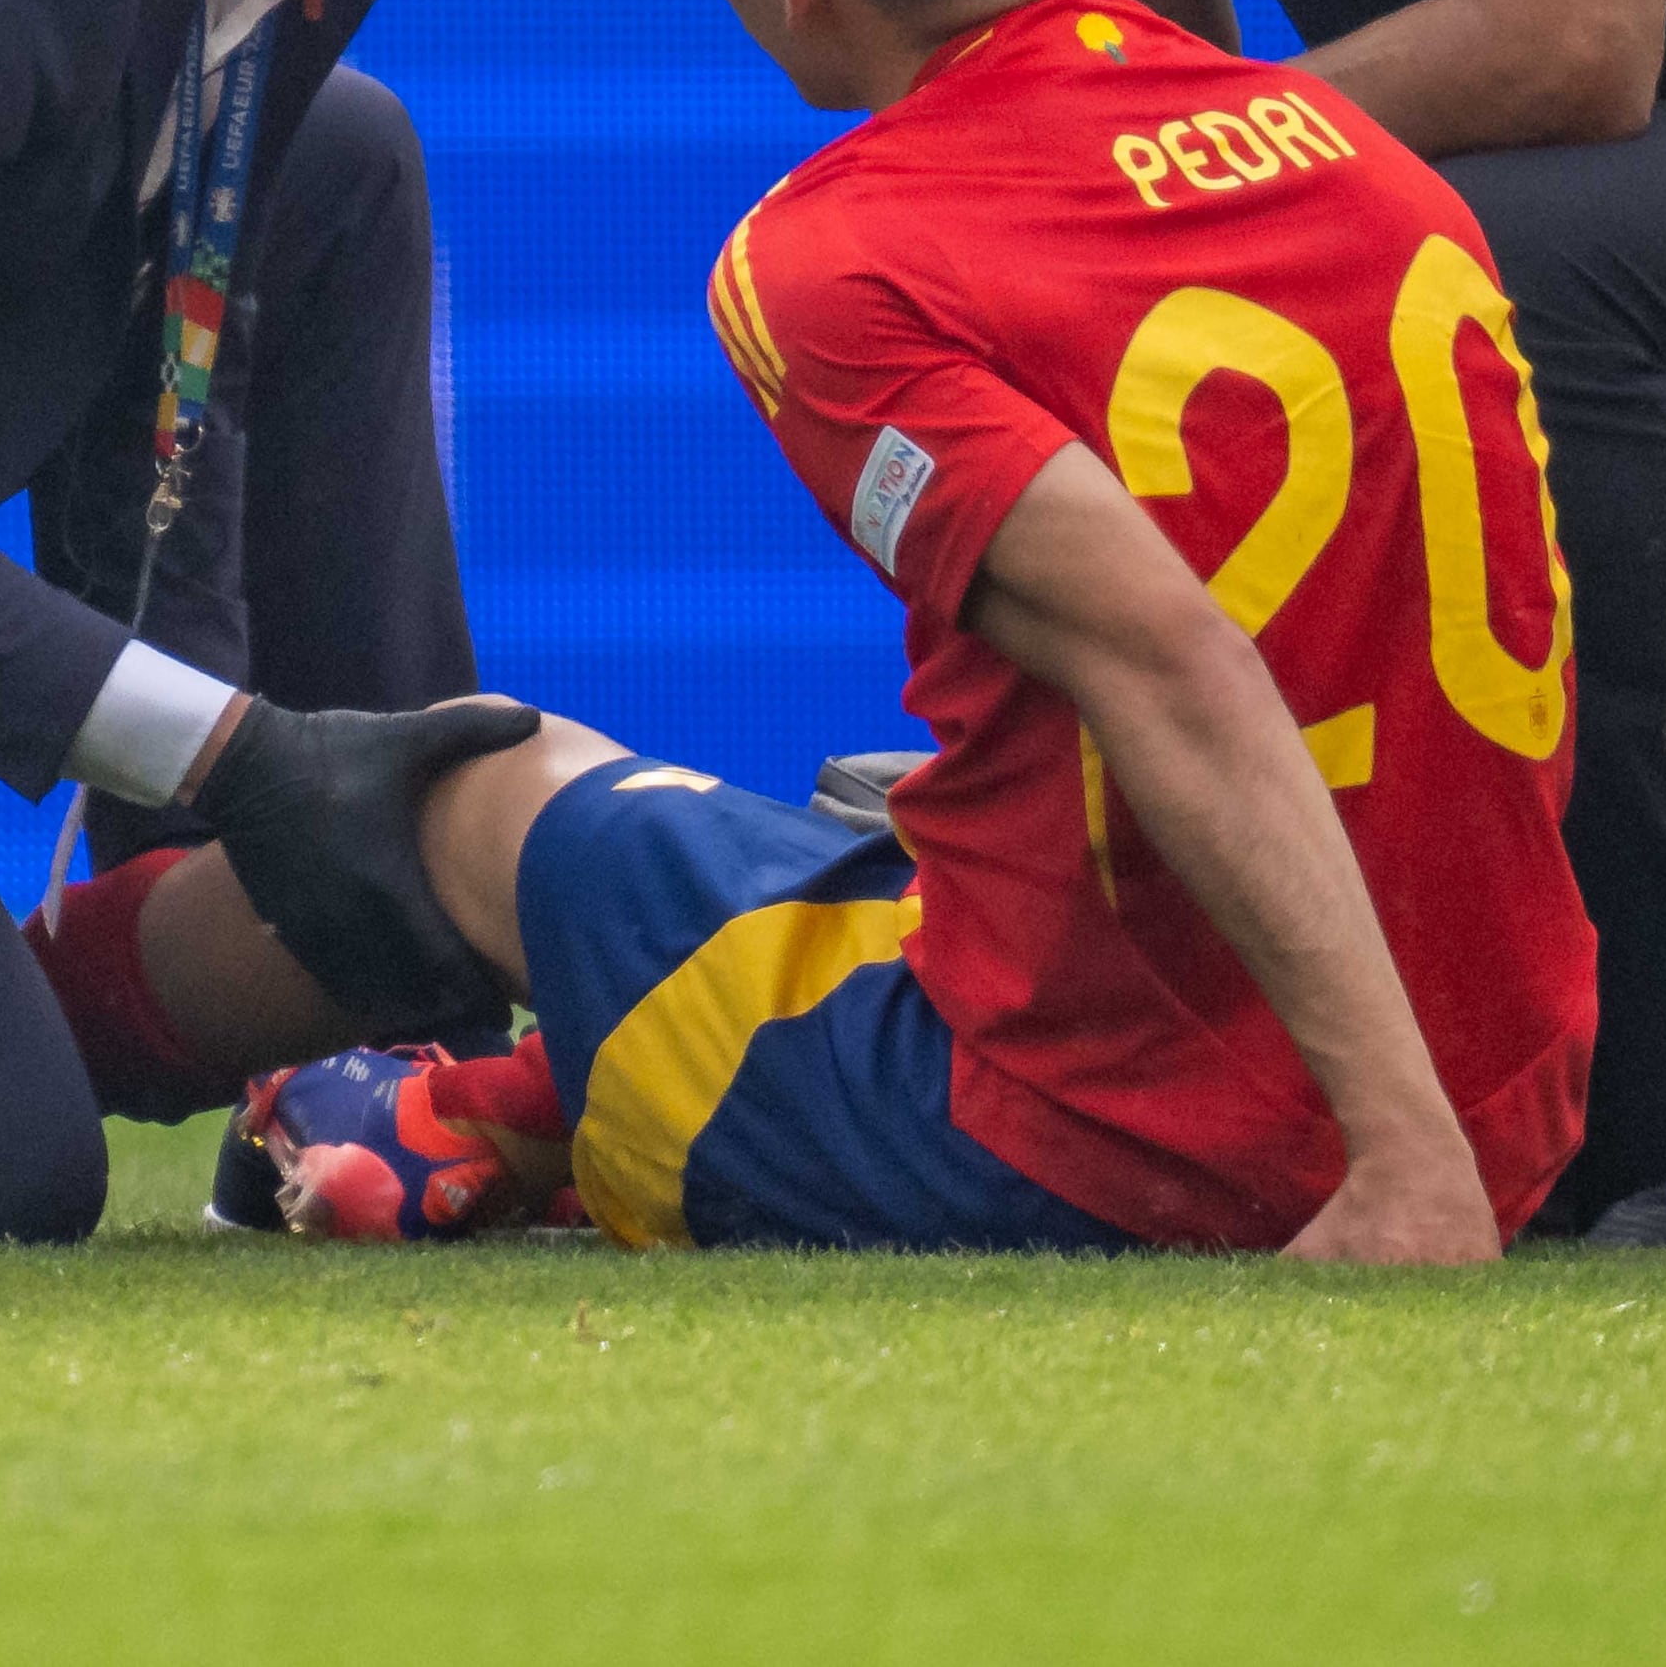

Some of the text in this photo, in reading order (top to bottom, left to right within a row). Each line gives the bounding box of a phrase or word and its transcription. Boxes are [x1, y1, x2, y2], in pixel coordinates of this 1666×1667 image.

[222, 109, 250, 169] UEFA
[1113, 91, 1357, 207] PEDRI
[1106, 232, 1573, 792] 20
